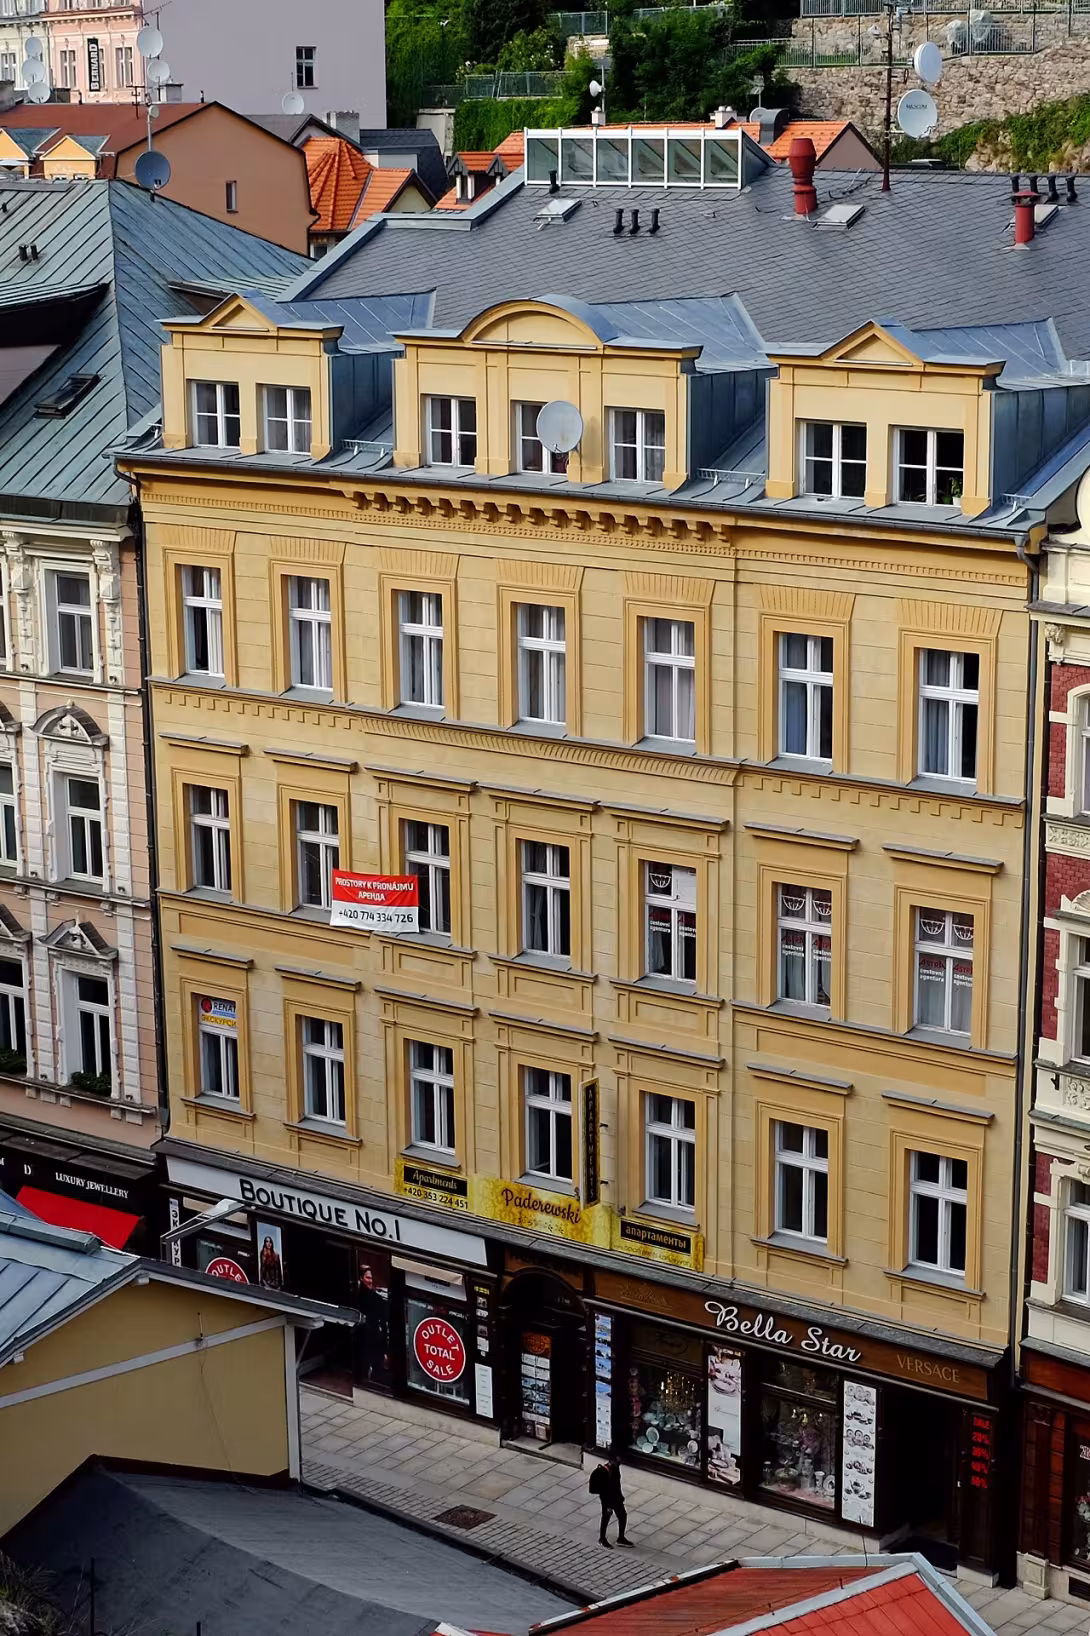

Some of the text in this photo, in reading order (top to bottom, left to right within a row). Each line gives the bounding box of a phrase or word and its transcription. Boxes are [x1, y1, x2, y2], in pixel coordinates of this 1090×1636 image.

[89, 44, 99, 90] BERNARD
[335, 877, 414, 891] PROSTORY K PRONÁJMU
[358, 891, 386, 901] АРЕНДА
[338, 908, 414, 923] +420 774 334 726
[55, 1172, 129, 1199] LUXURY JEWELLERY
[412, 1170, 458, 1190] Apartments
[239, 1178, 348, 1227] BOUTIQUE
[404, 1187, 468, 1210] +420 353 224 451
[501, 1187, 581, 1225] Paderewski
[625, 1225, 687, 1249] апартаменты
[421, 1324, 460, 1352] OUTLET
[704, 1301, 861, 1362] Bella Star
[424, 1343, 456, 1361] TOTAL
[426, 1359, 454, 1376] SALE
[897, 1354, 960, 1384] VERSACE
